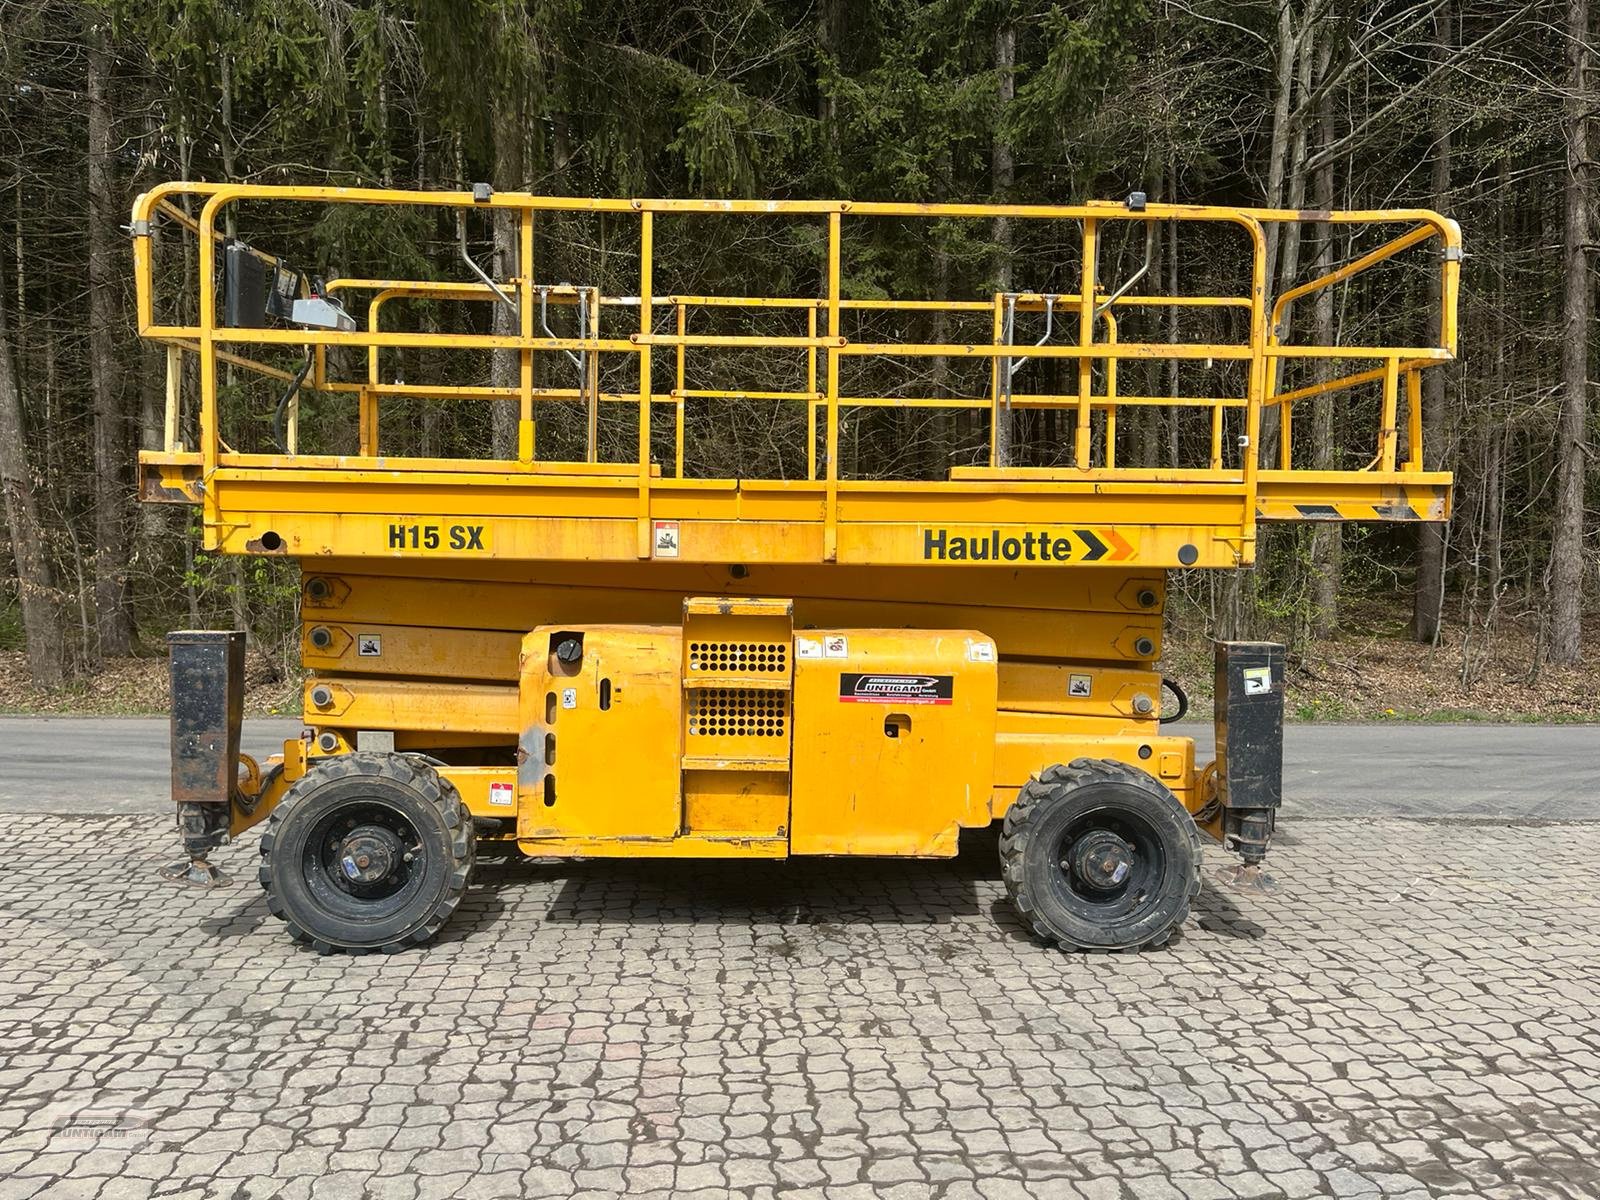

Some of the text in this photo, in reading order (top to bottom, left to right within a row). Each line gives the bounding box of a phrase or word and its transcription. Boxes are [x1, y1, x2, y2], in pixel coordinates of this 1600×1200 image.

[388, 524, 485, 550] H15 SX
[924, 529, 1072, 561] Haulotte
